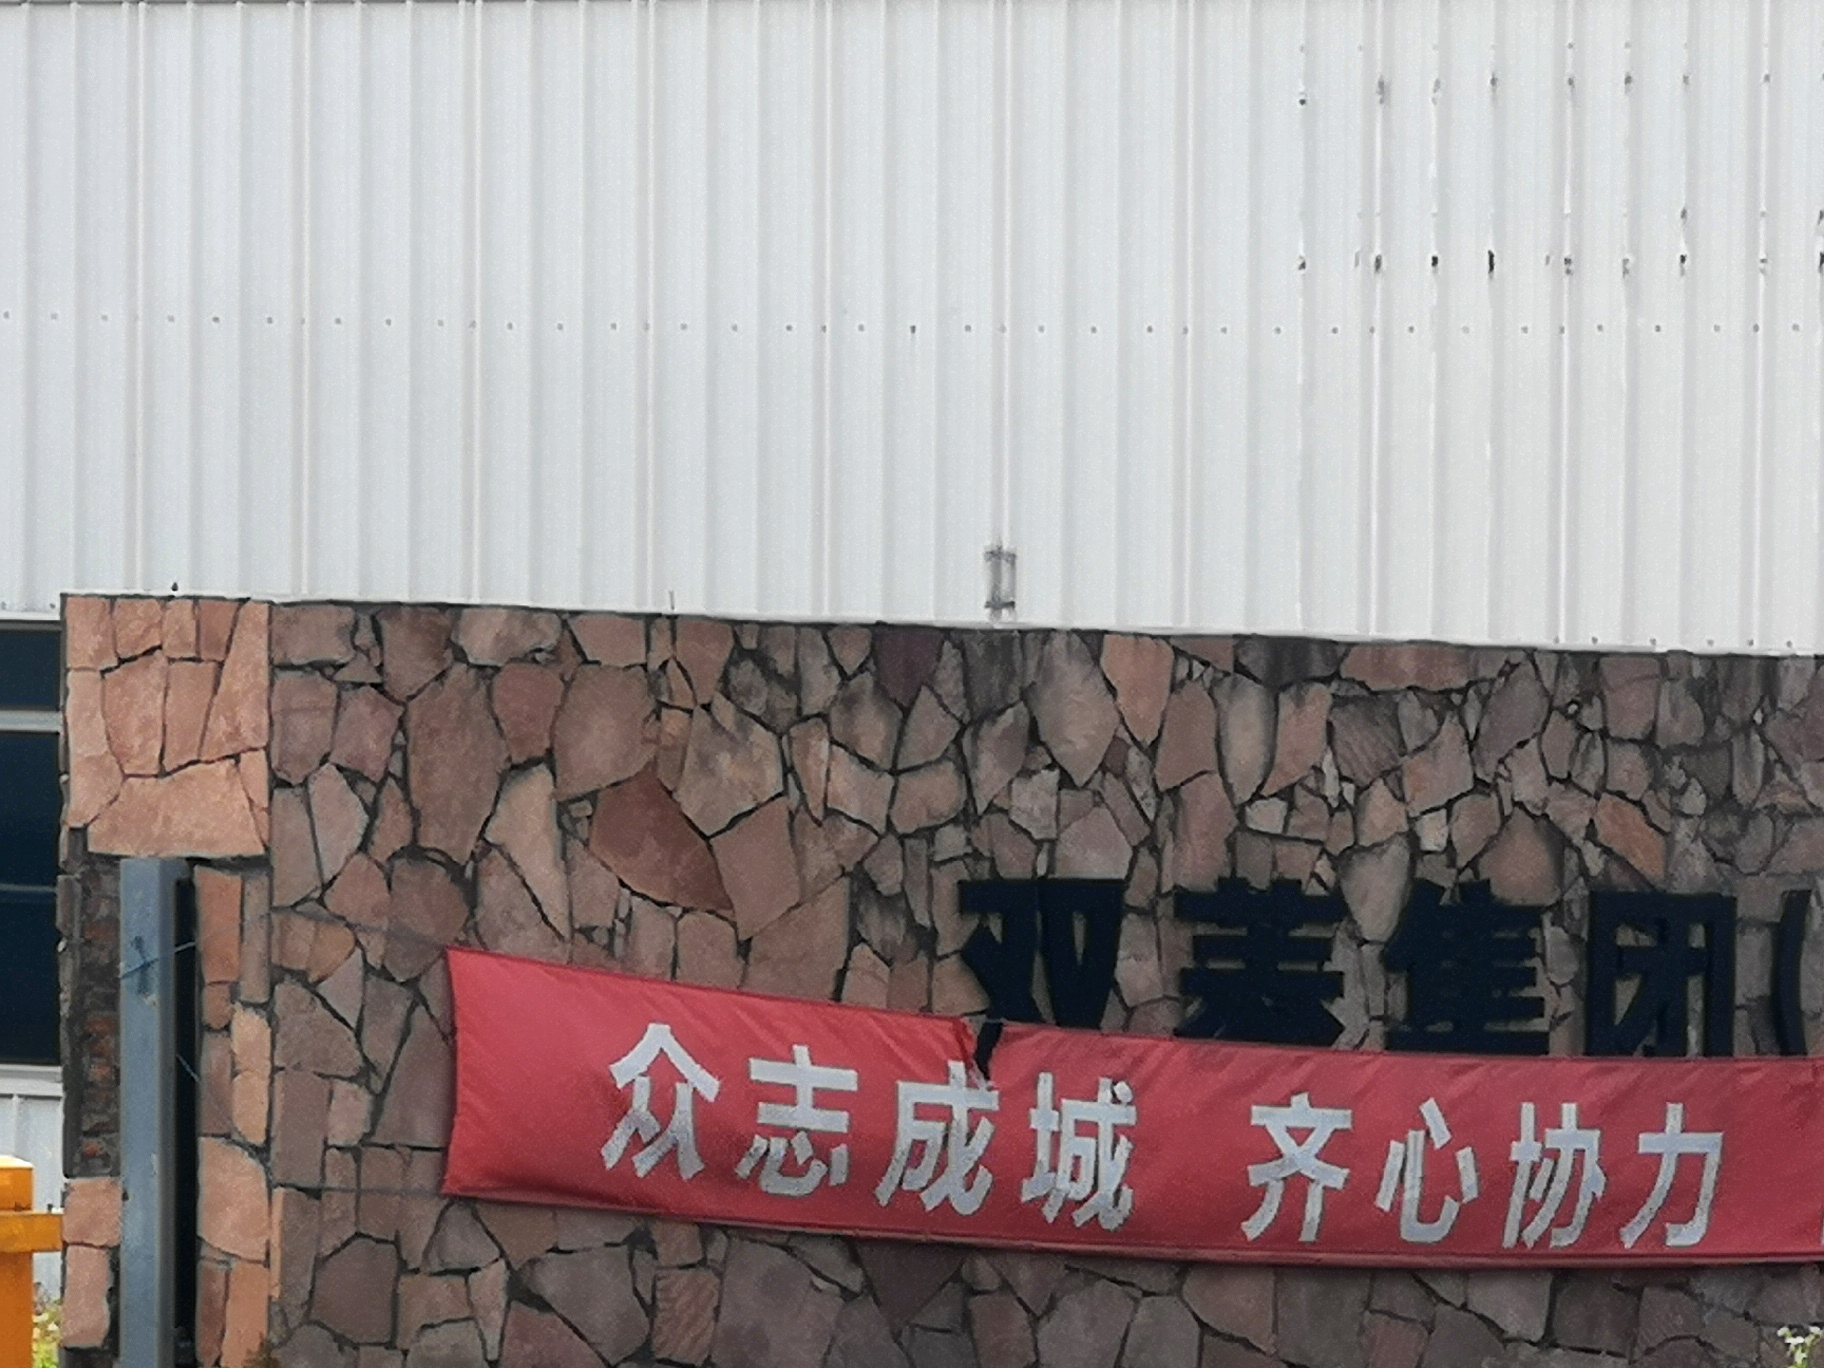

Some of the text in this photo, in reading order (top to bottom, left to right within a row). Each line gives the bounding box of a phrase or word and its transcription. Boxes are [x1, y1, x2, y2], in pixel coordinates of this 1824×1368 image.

[600, 1022, 1137, 1232] 众志成城
[1241, 1092, 1725, 1250] 齐心协力
